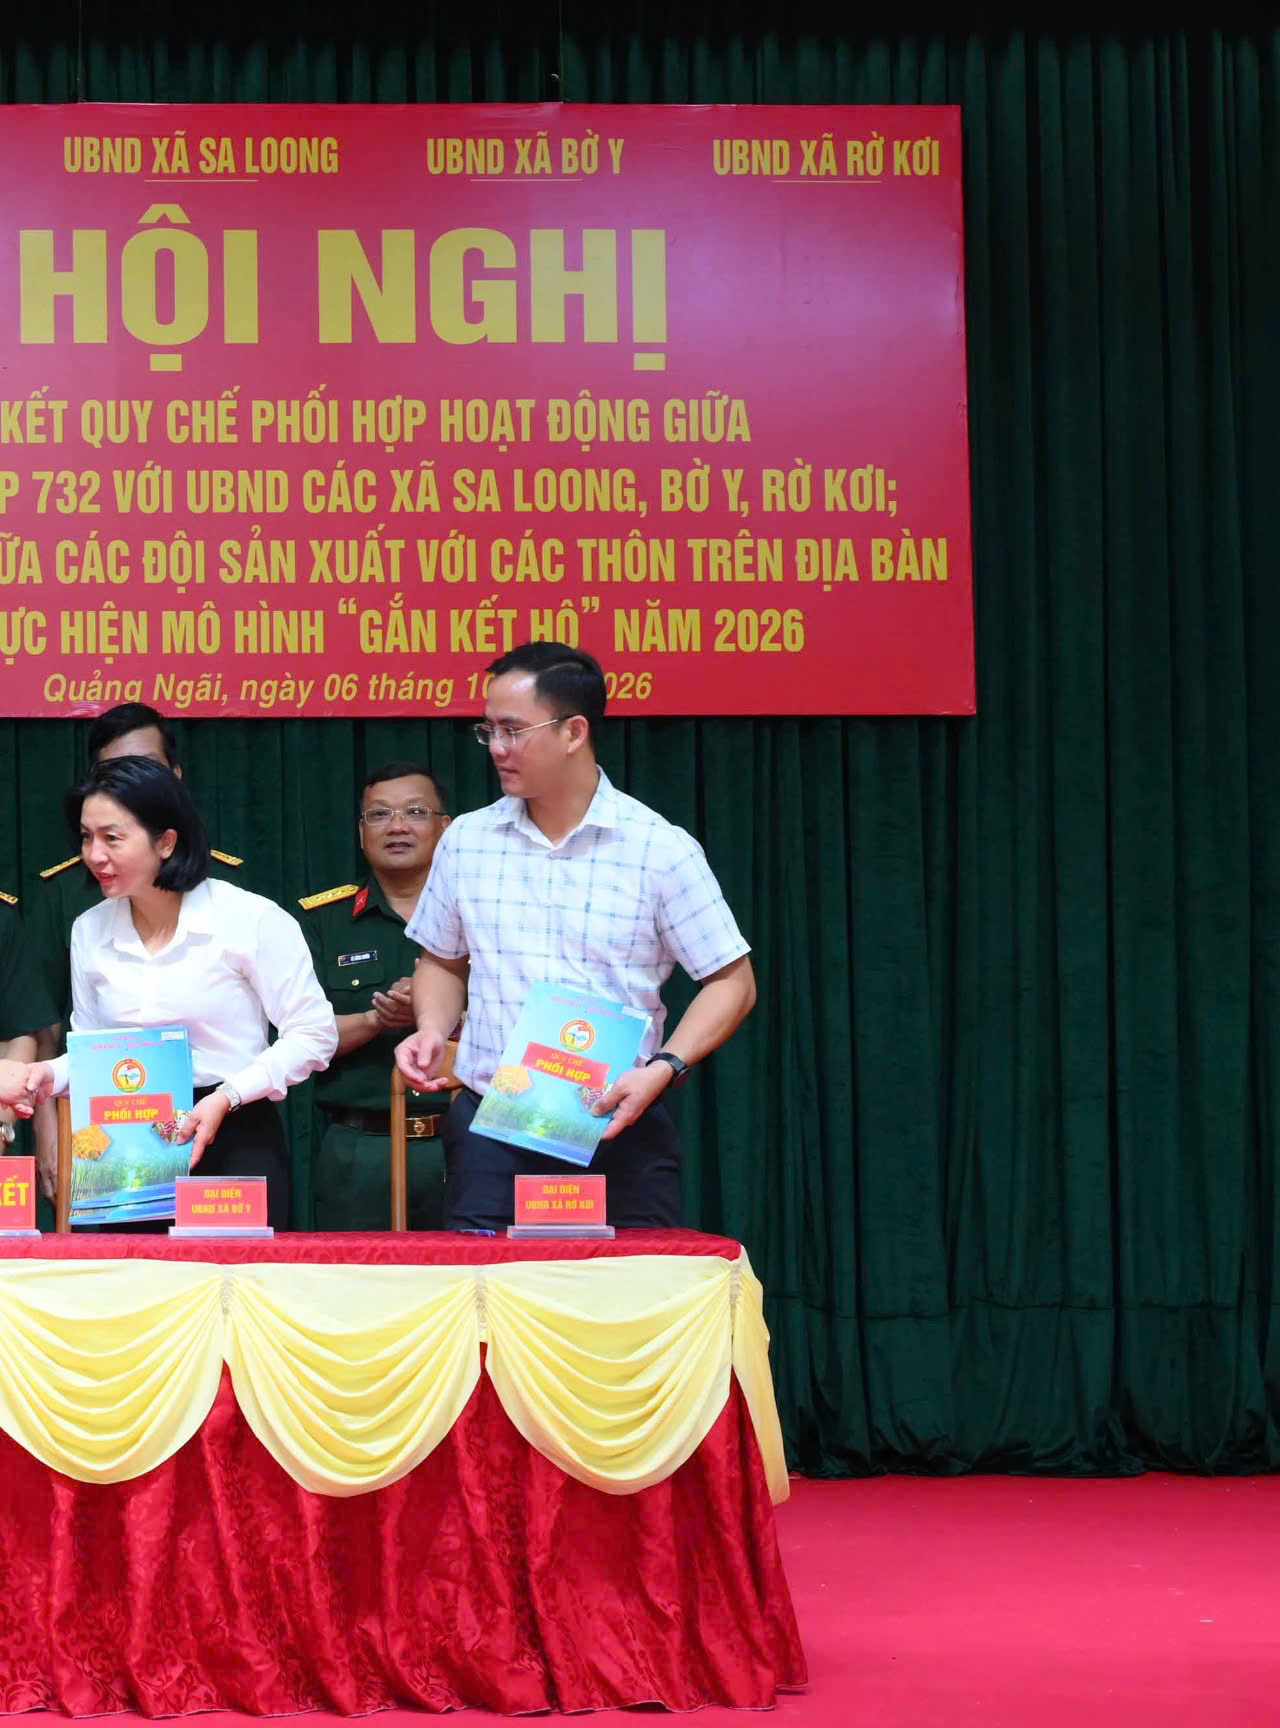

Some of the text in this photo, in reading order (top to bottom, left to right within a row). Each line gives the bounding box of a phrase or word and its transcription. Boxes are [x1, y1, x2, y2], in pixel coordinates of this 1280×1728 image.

[63, 130, 338, 174] UBND XÃ SA LOONG
[427, 131, 625, 175] UBND XÃ BỜ Y
[714, 131, 939, 176] UBND XÃ RỜ KƠI
[20, 203, 668, 372] HỘI NGHỊ
[0, 386, 69, 444] KẾT
[81, 399, 154, 449] QUY
[167, 385, 240, 444] CHẾ
[251, 383, 339, 444] PHỐI
[353, 395, 427, 453] HỢP
[441, 399, 537, 453] HOẠT
[548, 389, 651, 452] ĐỘNG
[664, 391, 752, 443] GIỮA
[31, 470, 102, 514] 732
[113, 460, 173, 513] VỚI
[187, 469, 289, 513] UBND
[303, 459, 377, 514] CÁC
[391, 460, 441, 513] XÃ
[453, 468, 502, 513] SA
[513, 468, 648, 517] LOONG,
[660, 458, 711, 513] BỜ
[723, 469, 749, 517] Y,
[763, 458, 812, 513] RỜ
[825, 463, 897, 516] KƠI;
[55, 530, 130, 585] CÁC
[143, 531, 206, 593] ĐỘI
[219, 524, 297, 584] SẢN
[309, 523, 406, 584] XUẤT
[416, 529, 477, 583] VỚI
[490, 529, 565, 583] CÁC
[577, 528, 676, 583] THÔN
[687, 528, 783, 582] TRÊN
[795, 538, 859, 592] ĐỊA
[871, 528, 948, 582] BÀN
[60, 600, 149, 665] HIỆN
[162, 600, 221, 655] MÔ
[234, 600, 325, 654] HÌNH
[338, 592, 437, 654] “GẮN
[449, 594, 518, 653] KẾT
[614, 599, 701, 652] NĂM
[714, 608, 805, 653] 2026
[153, 673, 228, 709] Ngãi,
[241, 679, 315, 709] ngày
[324, 673, 359, 702] 06
[369, 672, 454, 708] tháng
[603, 671, 653, 700] 026
[535, 1057, 564, 1075] PHỐI
[103, 1107, 132, 1121] PHỐI
